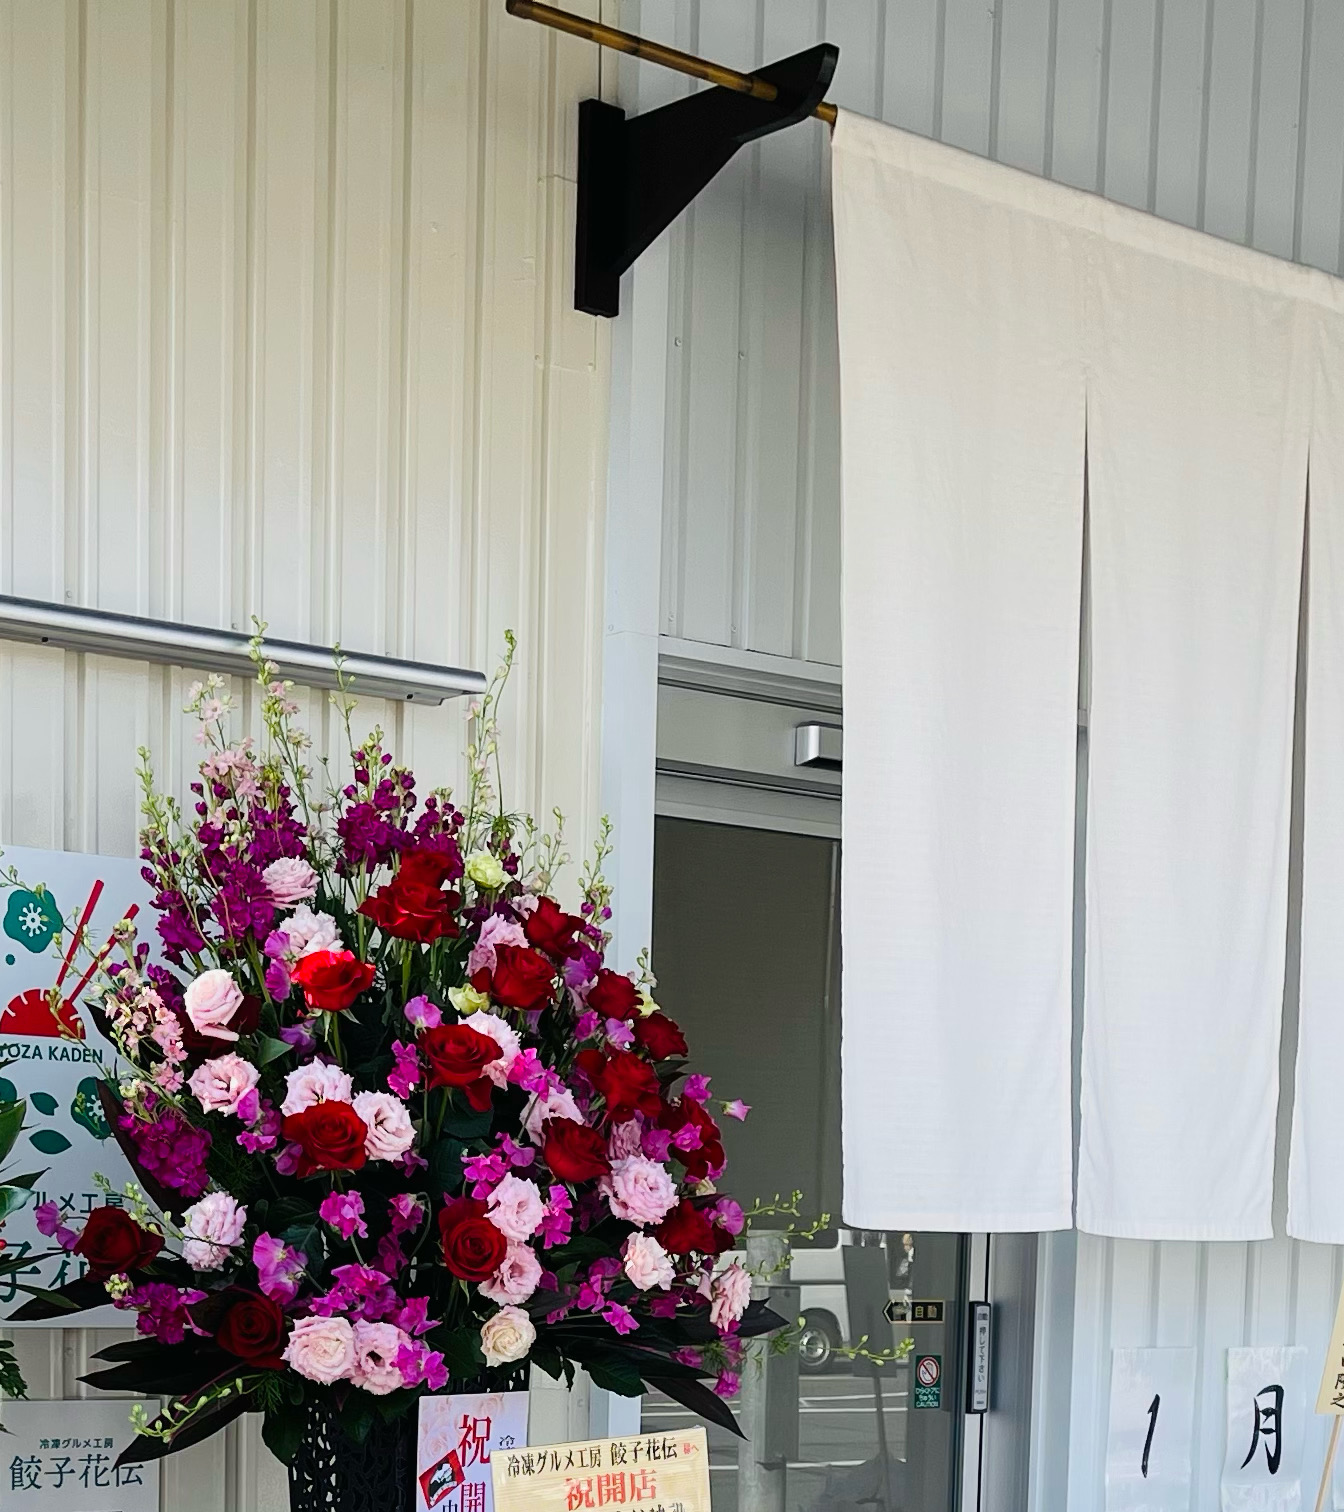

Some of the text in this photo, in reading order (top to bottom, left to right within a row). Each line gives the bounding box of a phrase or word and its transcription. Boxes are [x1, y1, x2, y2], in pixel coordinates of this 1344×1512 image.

[48, 1046, 103, 1064] KADEN
[9, 1453, 144, 1491] 餃子花伝
[507, 1445, 602, 1478] 冷凍グルメ工房
[610, 1437, 678, 1467] 餃子花伝
[564, 1468, 658, 1512] 祝開店
